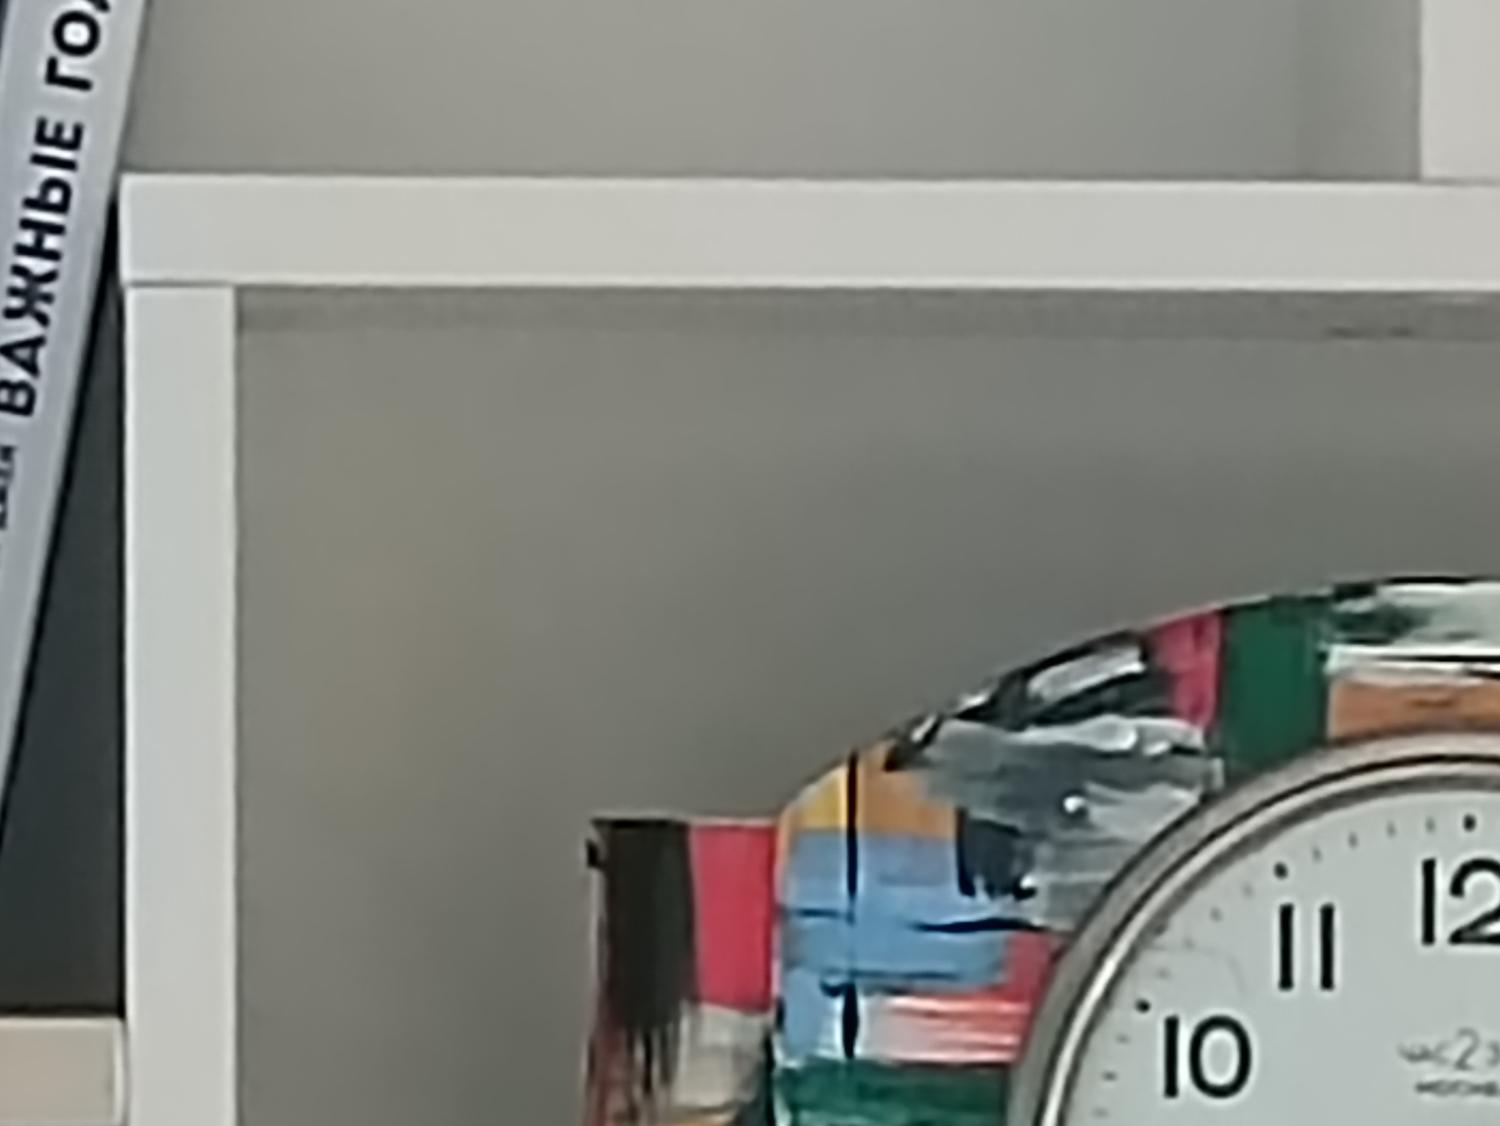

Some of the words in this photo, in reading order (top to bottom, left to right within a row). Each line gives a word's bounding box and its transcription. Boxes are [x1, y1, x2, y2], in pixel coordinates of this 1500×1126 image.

[0, 116, 85, 418] ВАЖНЫЕ
[44, 0, 111, 92] ГО
[1278, 903, 1335, 992] 11
[1163, 1014, 1253, 1099] 10
